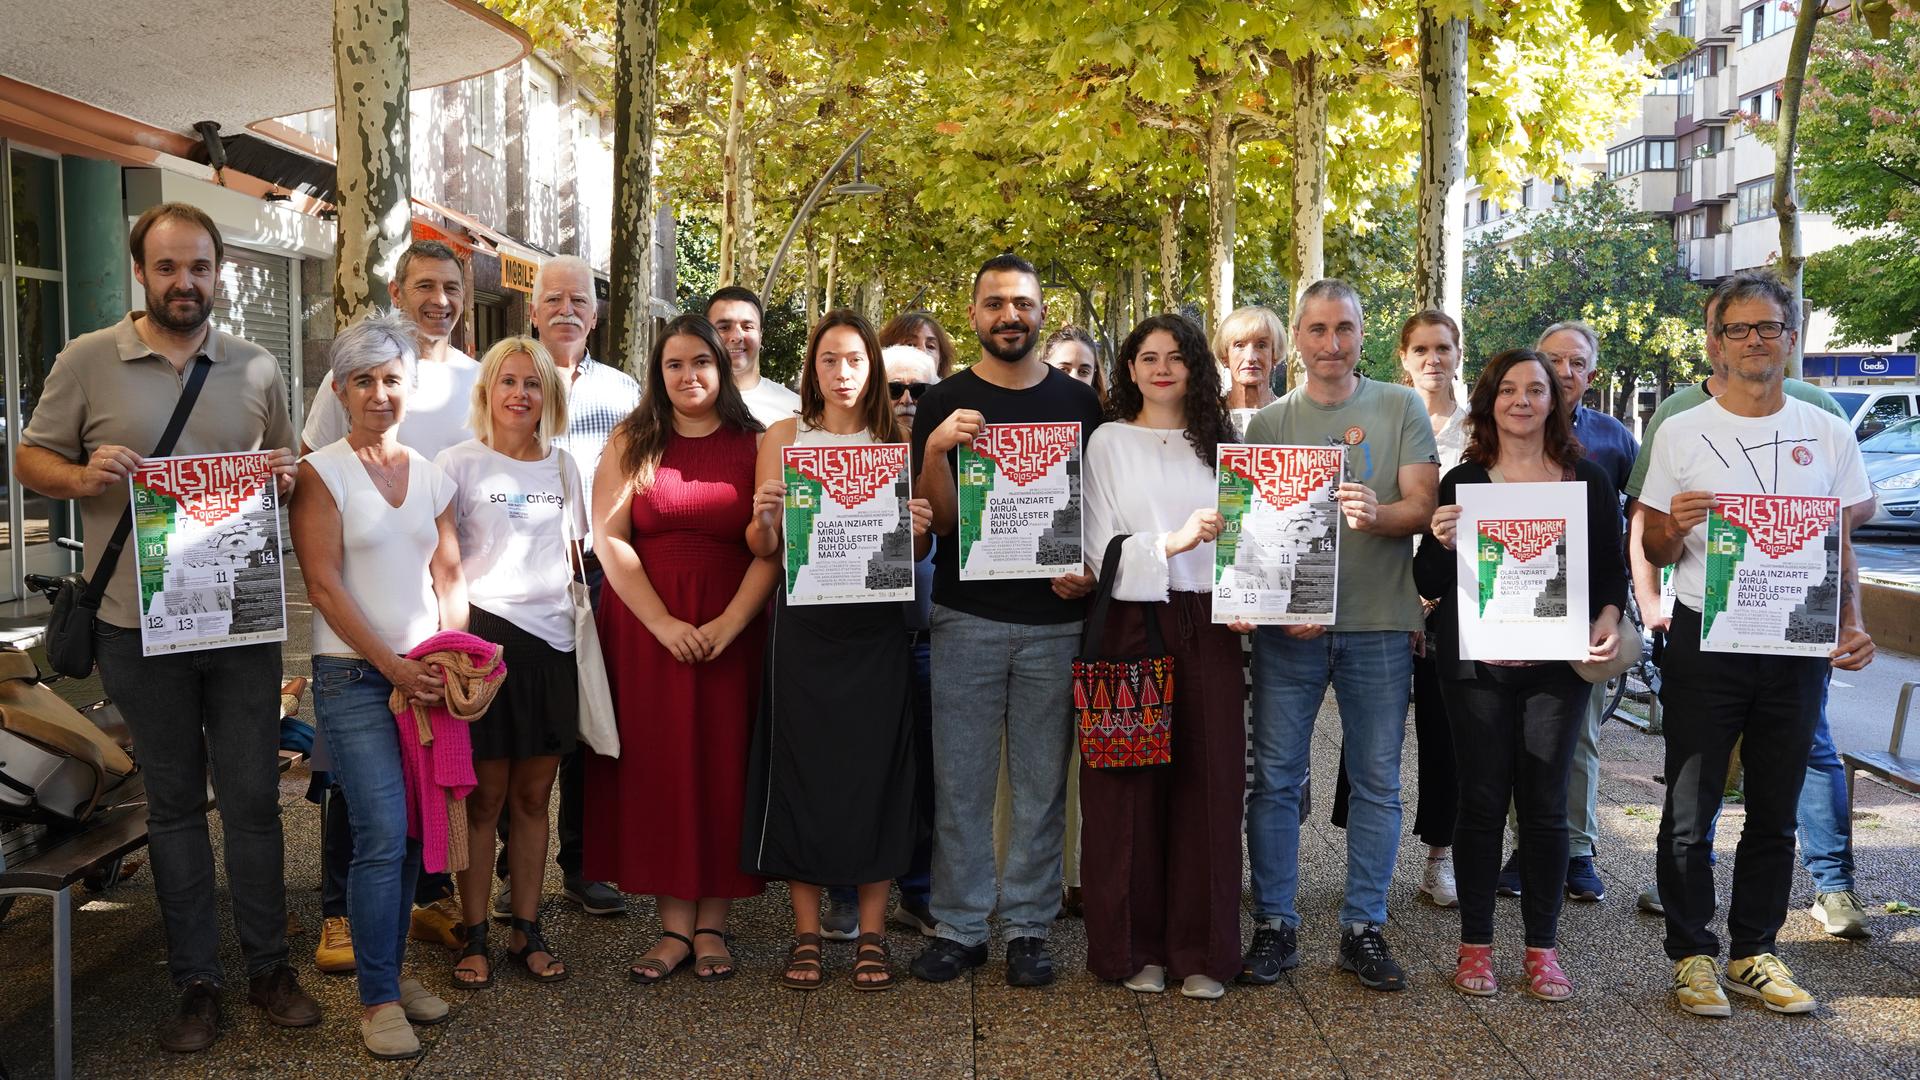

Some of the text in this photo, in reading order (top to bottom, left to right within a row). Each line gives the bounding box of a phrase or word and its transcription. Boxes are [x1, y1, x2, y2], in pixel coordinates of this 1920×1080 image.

[505, 259, 534, 289] MOBILE
[970, 463, 986, 486] 6
[1221, 472, 1231, 484] 6
[137, 491, 148, 504] 6
[796, 486, 813, 508] 6
[989, 496, 1055, 506] OLAIA INZIARTE
[262, 496, 272, 510] 9
[990, 505, 1018, 513] MIRUA
[990, 511, 1049, 520] JANUS LESTER
[817, 519, 883, 529] OLAIA INZIARTE
[990, 519, 1008, 527] RUH
[1009, 519, 1029, 527] DUO
[1225, 521, 1239, 533] 10
[817, 528, 846, 536] MIRUA
[990, 527, 1018, 535] MAIXA
[817, 534, 879, 544] JANUS LESTER
[1719, 532, 1736, 555] 6
[147, 543, 164, 557] 10
[818, 543, 837, 551] RUH
[838, 542, 858, 551] DUO
[1319, 539, 1333, 551] 14
[260, 551, 275, 565] 14
[818, 550, 847, 559] MAIXA
[1280, 553, 1291, 564] 11
[1485, 545, 1498, 562] 6
[215, 571, 228, 583] 11
[1738, 569, 1809, 580] OLAIA INZIARTE
[1738, 577, 1768, 585] MIRUA
[1737, 584, 1802, 594] JANUS LESTER
[1217, 587, 1232, 599] 12
[1243, 592, 1257, 604] 13
[1737, 592, 1757, 600] RUH
[1758, 592, 1780, 601] DUO
[1737, 599, 1767, 608] MAIXA
[147, 616, 164, 629] 12
[177, 618, 194, 631] 13
